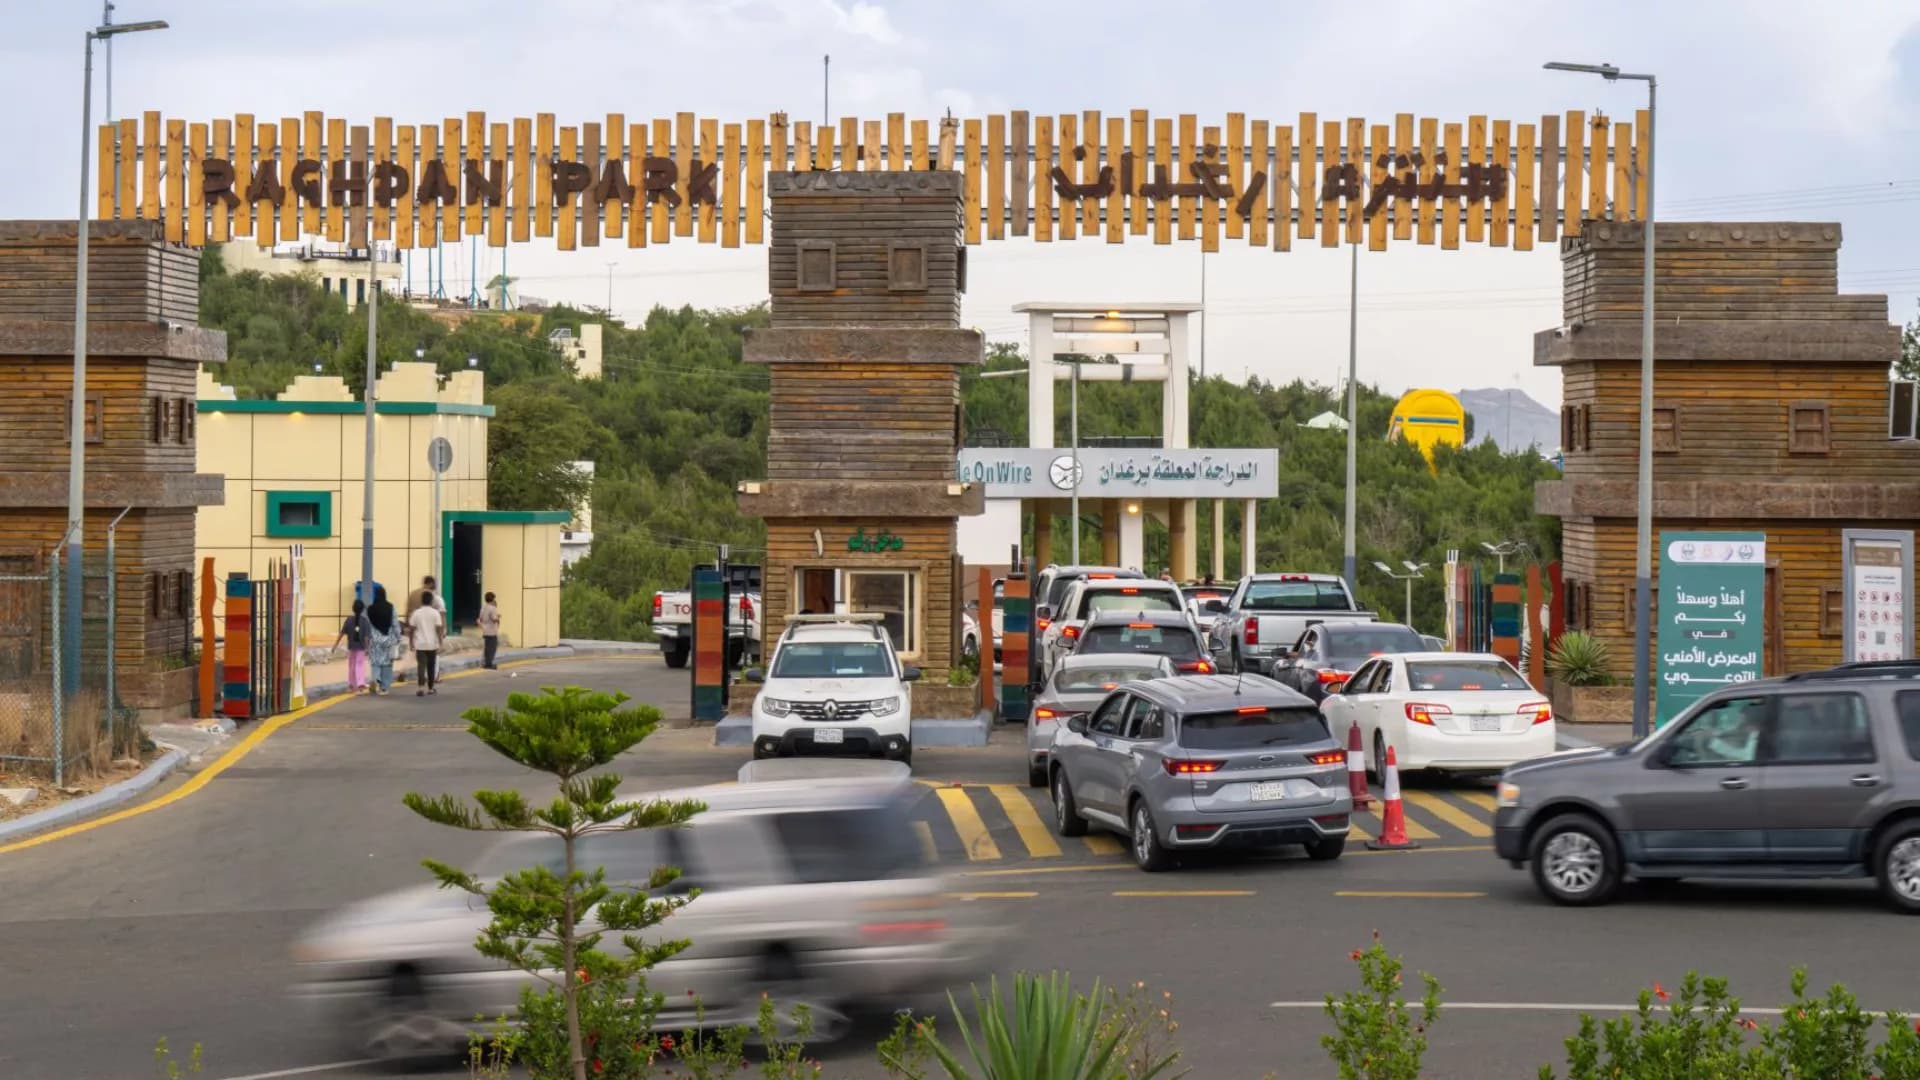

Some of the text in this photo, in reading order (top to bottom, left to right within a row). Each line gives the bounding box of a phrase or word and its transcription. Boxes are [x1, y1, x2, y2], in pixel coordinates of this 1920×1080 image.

[201, 157, 720, 209] RAGHDAN PARK
[1051, 143, 1267, 217] رغدان
[1692, 629, 1728, 640] في
[1707, 651, 1757, 668] المعرض
